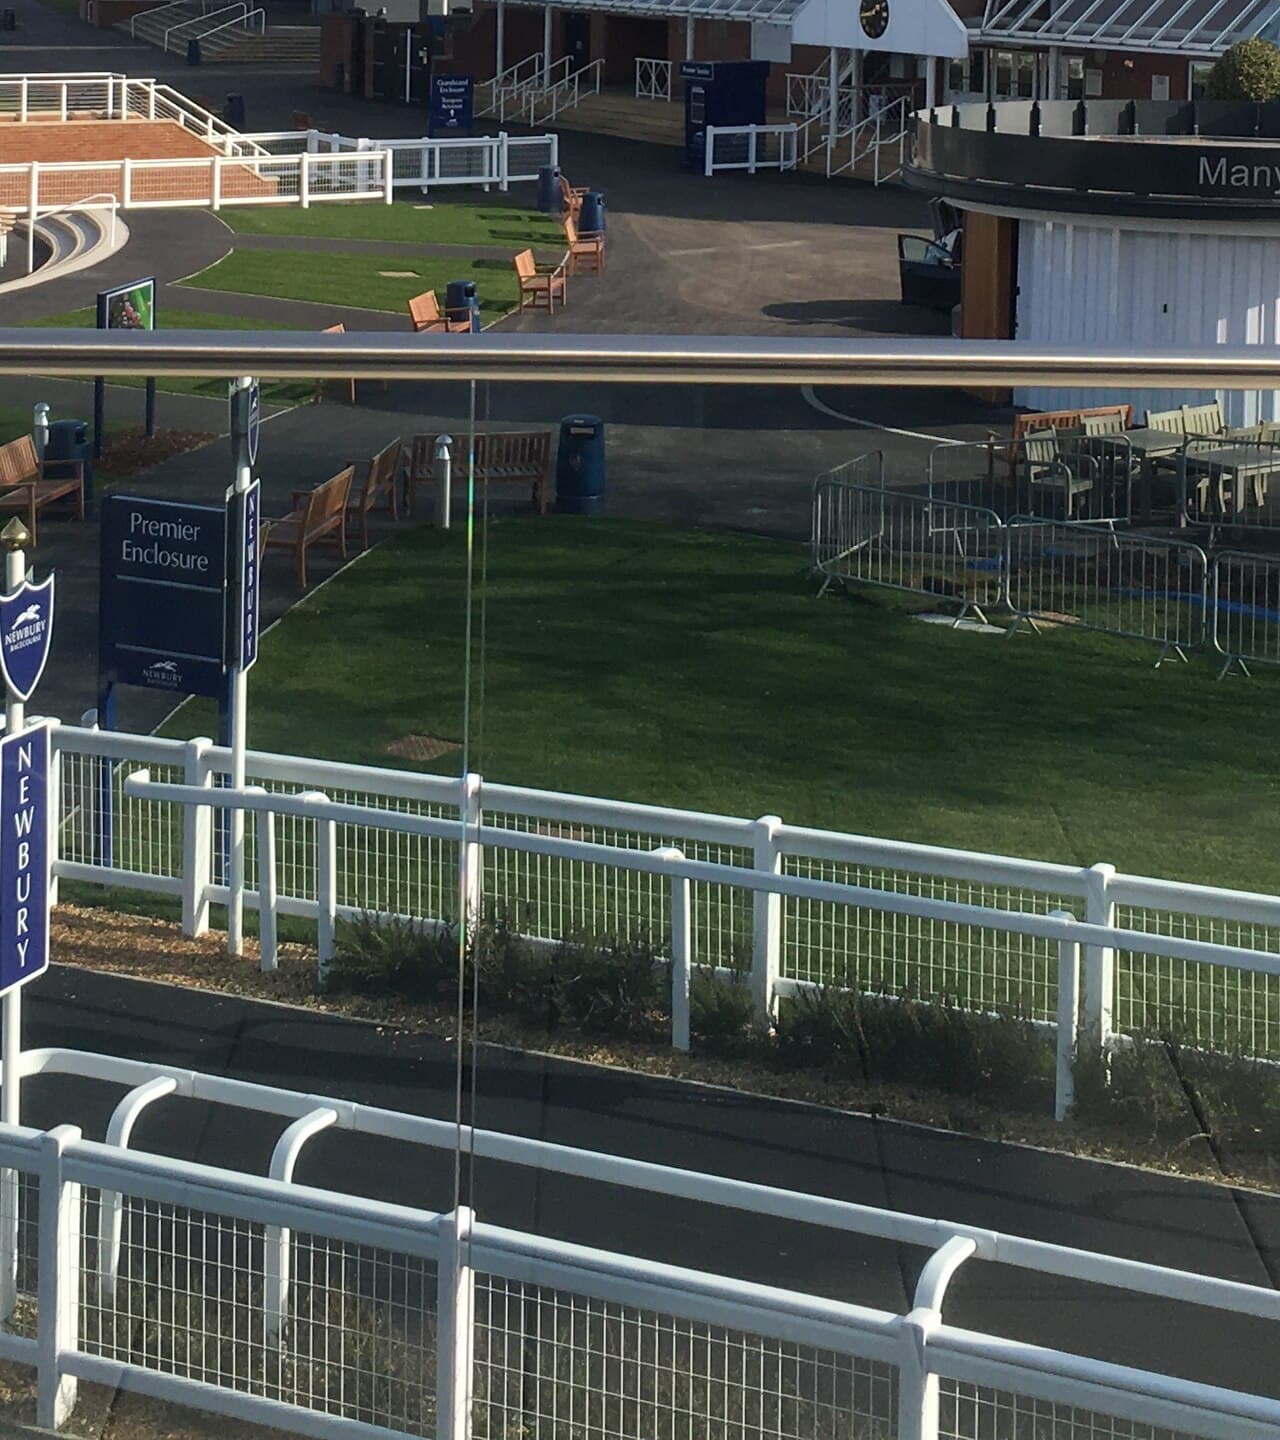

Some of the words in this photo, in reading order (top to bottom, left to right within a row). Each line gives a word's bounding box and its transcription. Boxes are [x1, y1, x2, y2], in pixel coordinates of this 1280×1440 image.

[130, 512, 202, 542] Premier
[122, 539, 209, 572] Enclosure
[5, 619, 47, 646] NEWBURY
[13, 741, 35, 969] NEWBURY
